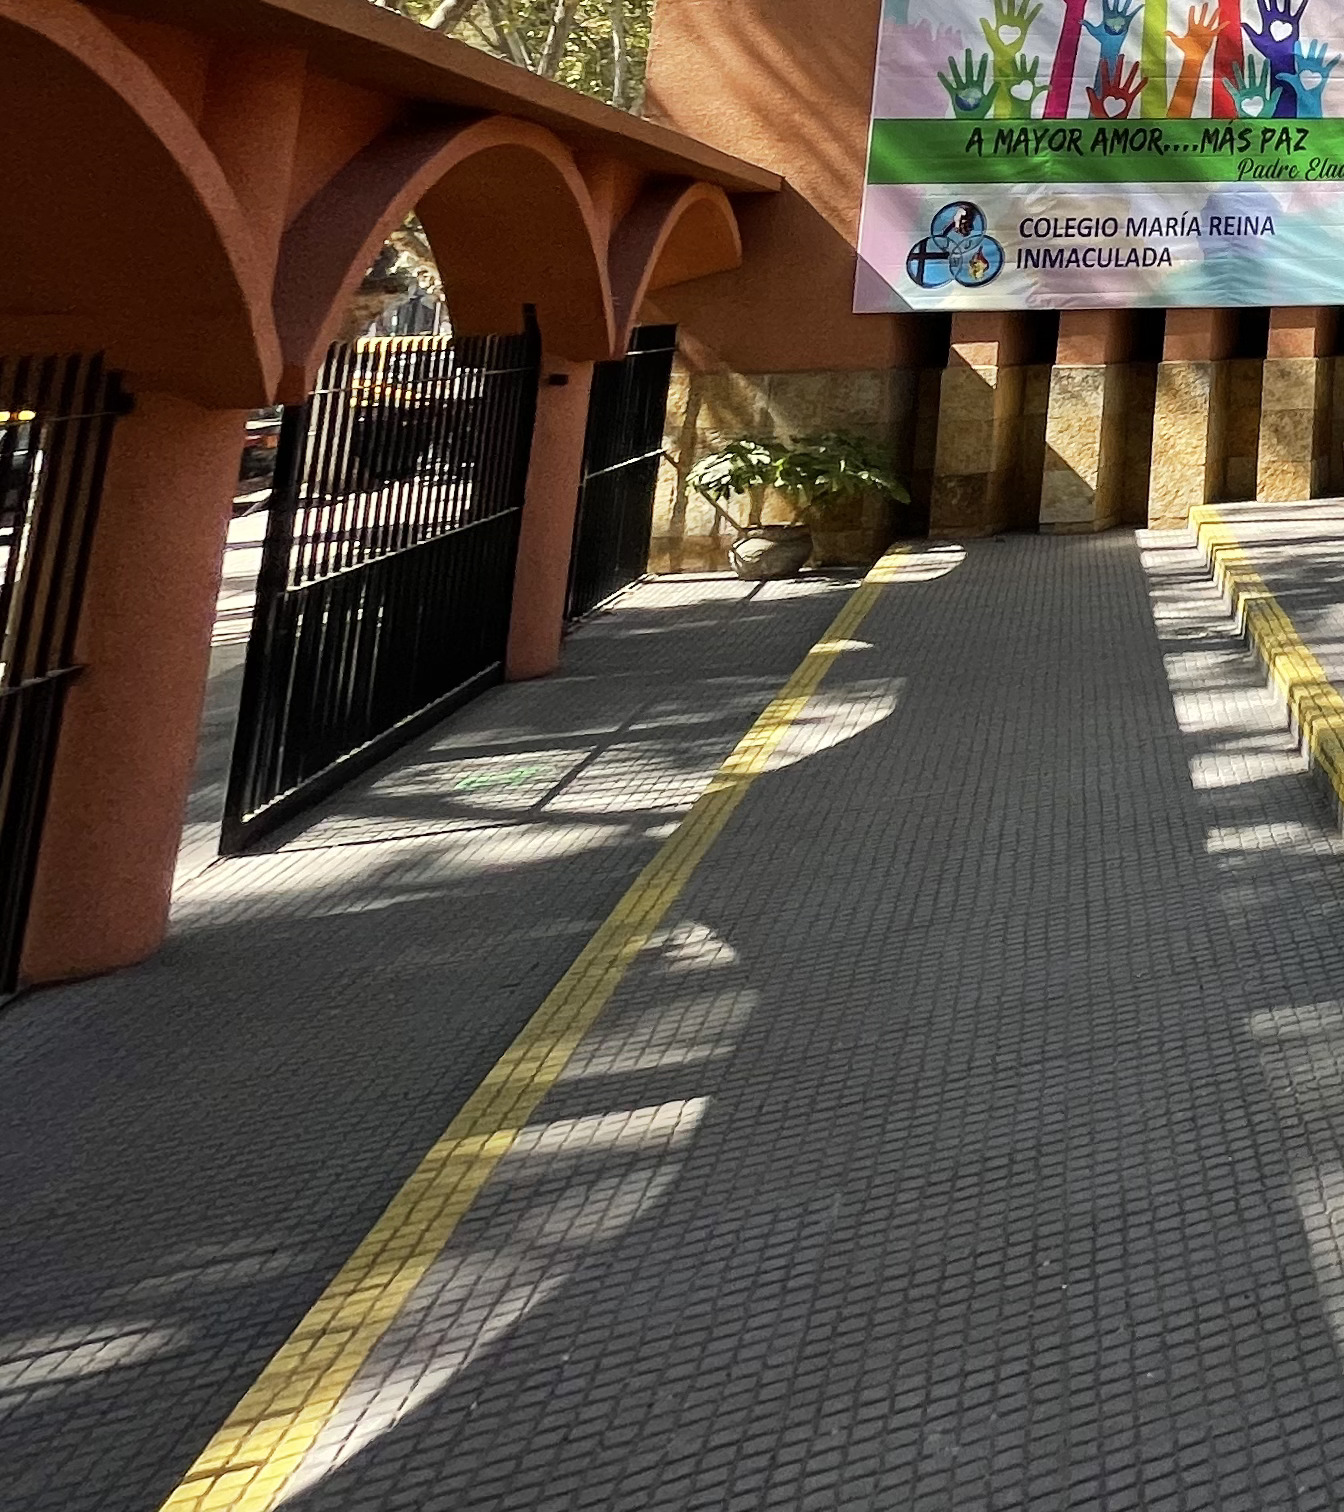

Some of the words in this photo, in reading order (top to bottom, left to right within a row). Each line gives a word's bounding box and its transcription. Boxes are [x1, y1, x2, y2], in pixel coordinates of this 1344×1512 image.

[966, 128, 984, 156] A
[994, 128, 1083, 154] MAYOR
[1259, 127, 1310, 153] PAZ
[1236, 158, 1299, 181] Padre
[1019, 217, 1119, 239] COLEGIO
[1126, 211, 1202, 238] MARÍA
[1208, 214, 1276, 237] REINA
[1016, 246, 1173, 269] INMACULADA
